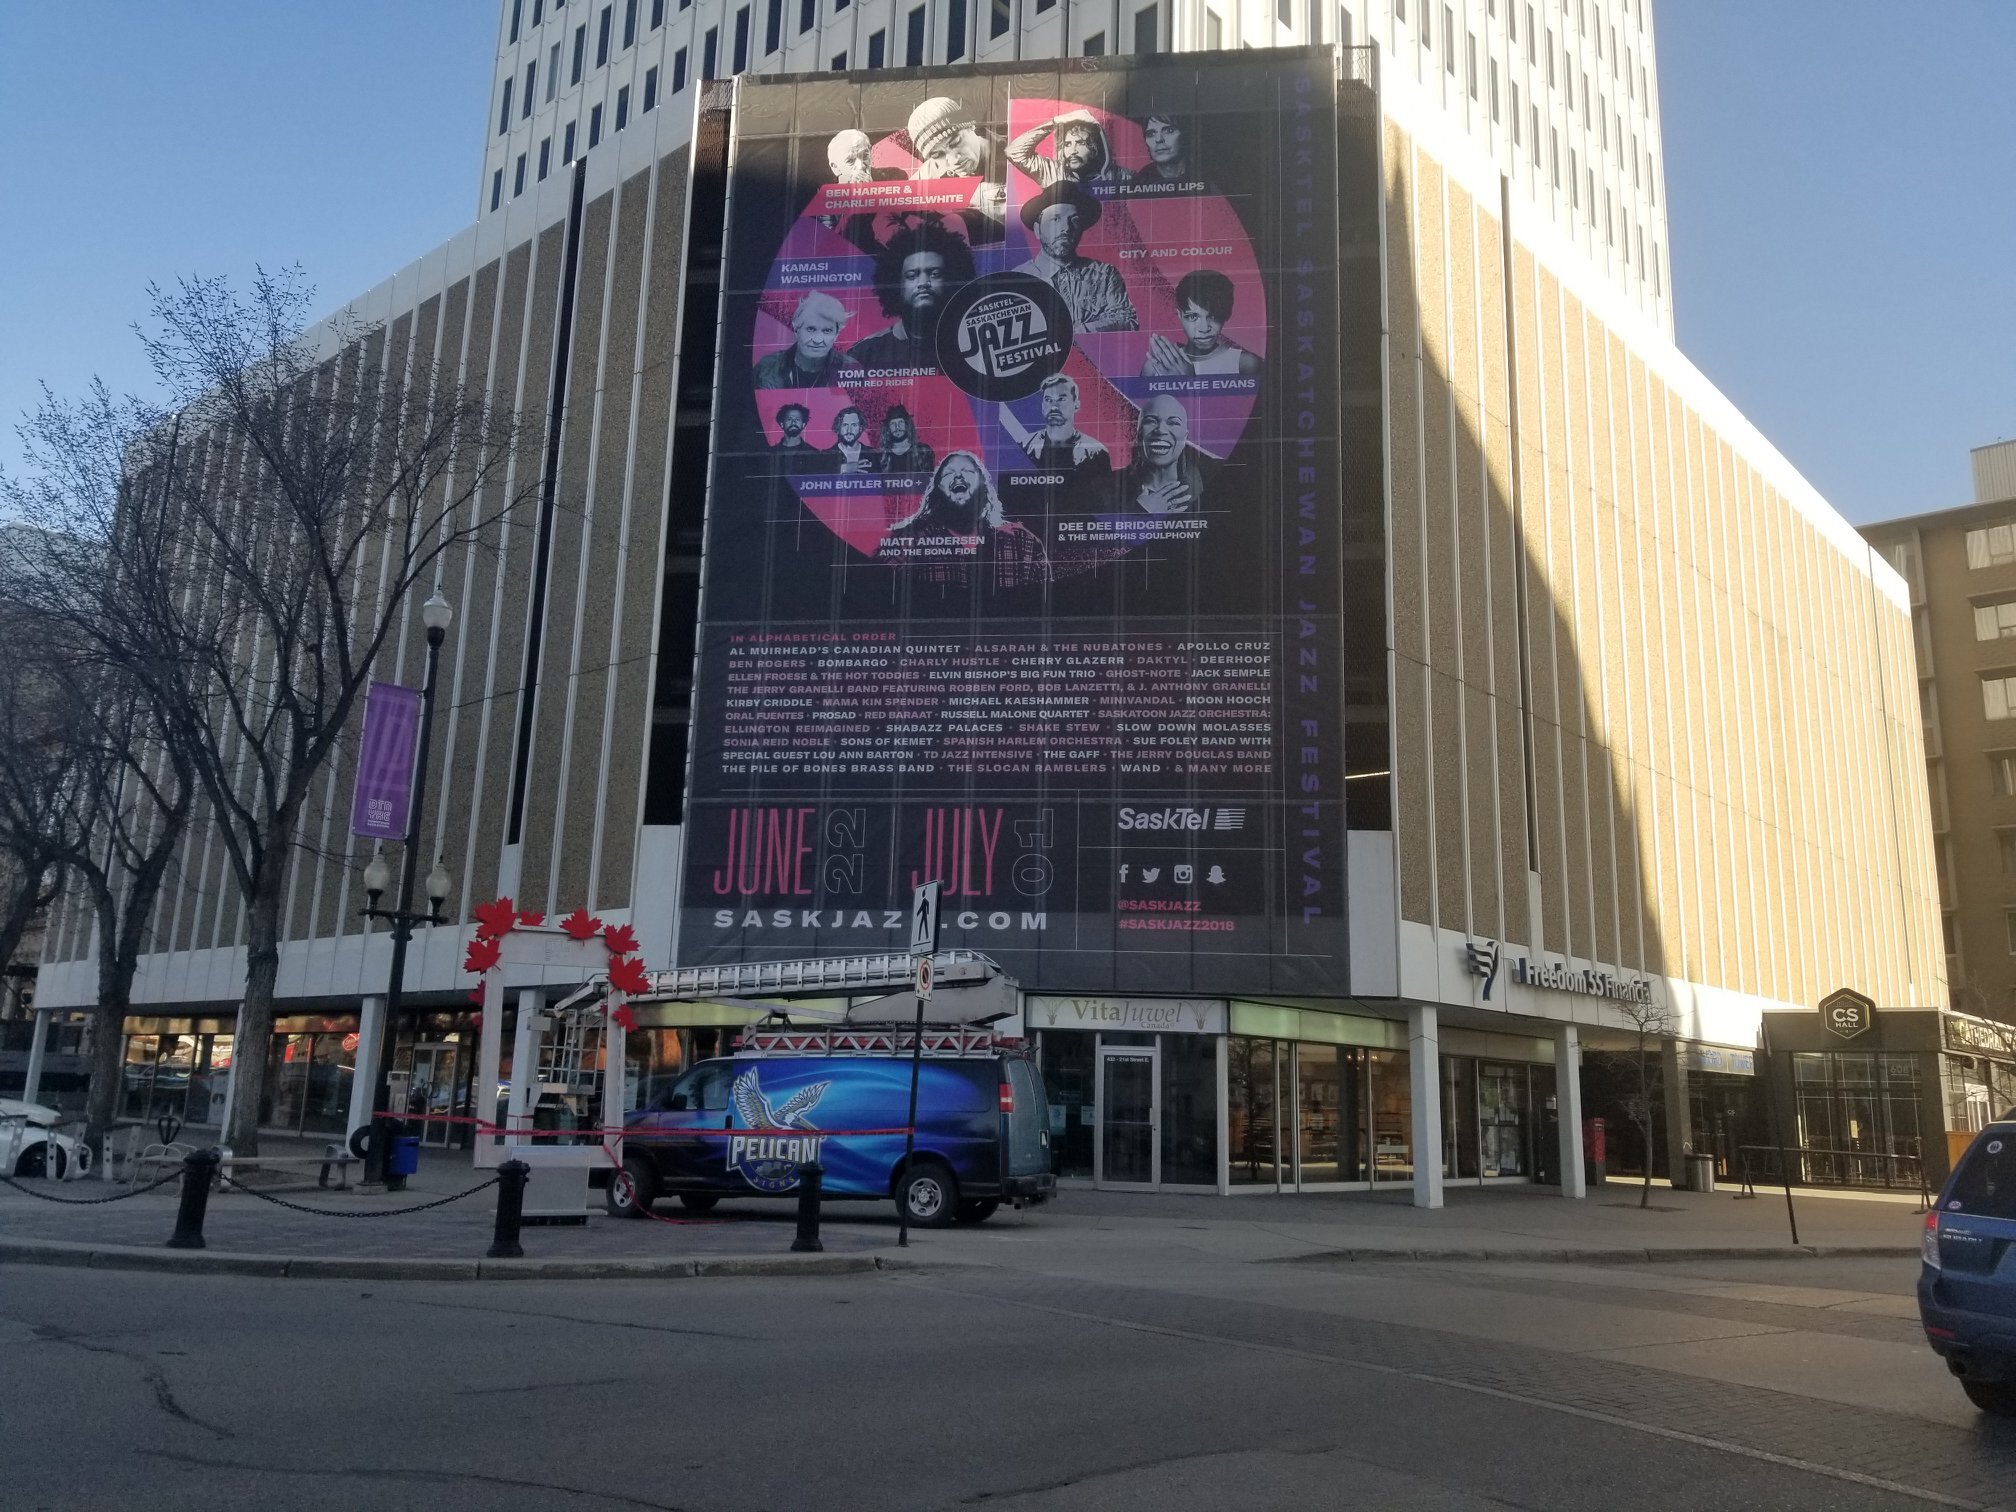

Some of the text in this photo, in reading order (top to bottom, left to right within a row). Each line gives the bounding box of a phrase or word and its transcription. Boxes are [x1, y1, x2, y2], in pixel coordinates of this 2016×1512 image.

[826, 185, 912, 198] BEN HARPER &
[1092, 181, 1205, 195] THE FLAMING LIPS
[824, 194, 964, 209] CHARLIE MUSSELWHITE
[1119, 246, 1233, 259] CITY AND COLOUR
[781, 262, 829, 272] KAMASI
[781, 273, 862, 284] WASHINGTON
[978, 298, 1014, 314] SASKTEL
[966, 304, 1032, 327] SASKATCHEWAN
[960, 311, 1048, 377] JAZZ
[999, 342, 1062, 367] FESTIVAL
[838, 367, 936, 379] TOM COCHRANE
[837, 380, 862, 388] WITH
[885, 378, 914, 387] RIDER
[1149, 379, 1256, 391] KELLYLEE EVANS
[800, 480, 833, 491] JOHN
[836, 479, 882, 489] BUTLER
[884, 478, 913, 488] TRIO
[1010, 476, 1065, 486] BONOBO
[1294, 76, 1322, 925] SASKTEL SASKATCHEWAN JAZZ FESTIVAL
[1058, 520, 1208, 531] DEE DEE BRIDGEWATER
[880, 536, 986, 548] MATT ANDERSEN
[1089, 532, 1137, 540] MEMPHIS
[1138, 531, 1201, 540] SOULPHONY
[730, 632, 896, 643] IN ALPHABETICAL ORDER
[730, 642, 1271, 656] AL MUIRHEAD'S CANADIAN QUINTET ALSARAH & THE NUBATONES APOLLO CRUZ
[729, 655, 1271, 669] BEN ROGERS BOMBARGO CHARLY HUSTLE CHERRY GLAZERR DAKTYL DEERHOOF
[728, 669, 1271, 682] ELLEN FROESE & THE HOT TODDIES ELVIN BISHOP'S BIG FUN TRIO GHOST-NOTE JACK SEMPLE
[726, 696, 1271, 707] KIRBY CRIDDLE MAMA KIN SPENDER MICHAEL KAESHAMMER MINIVANDAL MOON HOOCH
[725, 710, 1271, 721] ORAL FUENTES PROSAD RED BARAAT RUSSELL MALONE QUARTET SASKATOON JAZZ ORCHESTRA:
[724, 723, 1272, 734] ELLINGTON REIMAGINED SHABAZZ PALACES SHAKE STEW SLOW DOWN MOLASSES
[722, 764, 1272, 773] THE PILE OF BONES BRASS BAND THE SLOCAN RAMBLERS WAND & MANY MORE
[1118, 807, 1210, 830] SaskTel
[713, 808, 816, 895] JUNE
[823, 808, 866, 894] 22
[911, 808, 1004, 896] JULY
[1118, 900, 1202, 912] @SASKJAZZ
[713, 909, 1047, 930] SASKJAZ.COM
[1119, 919, 1235, 931] #SASKJAZZ2018
[1526, 959, 1587, 994] Freedom
[1587, 970, 1604, 997] 55
[1832, 1008, 1859, 1023] CS
[732, 1136, 817, 1164] PELICAN
[753, 1176, 794, 1190] SIGNS
